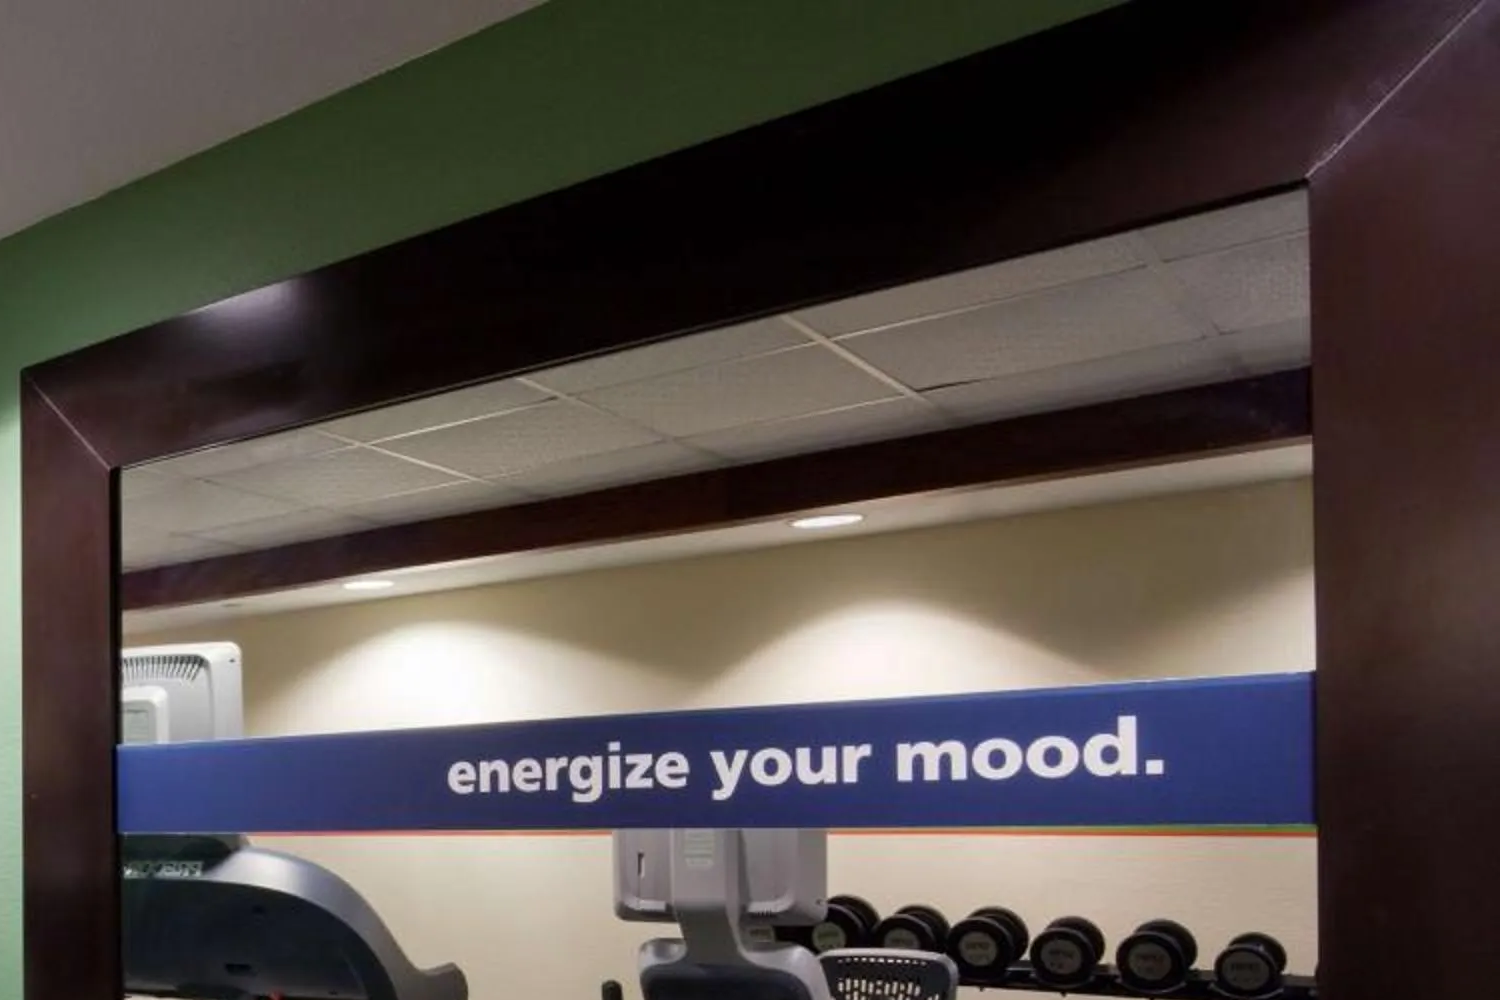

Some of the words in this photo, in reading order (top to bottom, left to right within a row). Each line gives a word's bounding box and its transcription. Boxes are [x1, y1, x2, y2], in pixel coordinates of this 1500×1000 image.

[446, 740, 691, 803] energize
[709, 743, 873, 801] your
[895, 714, 1165, 783] mood.
